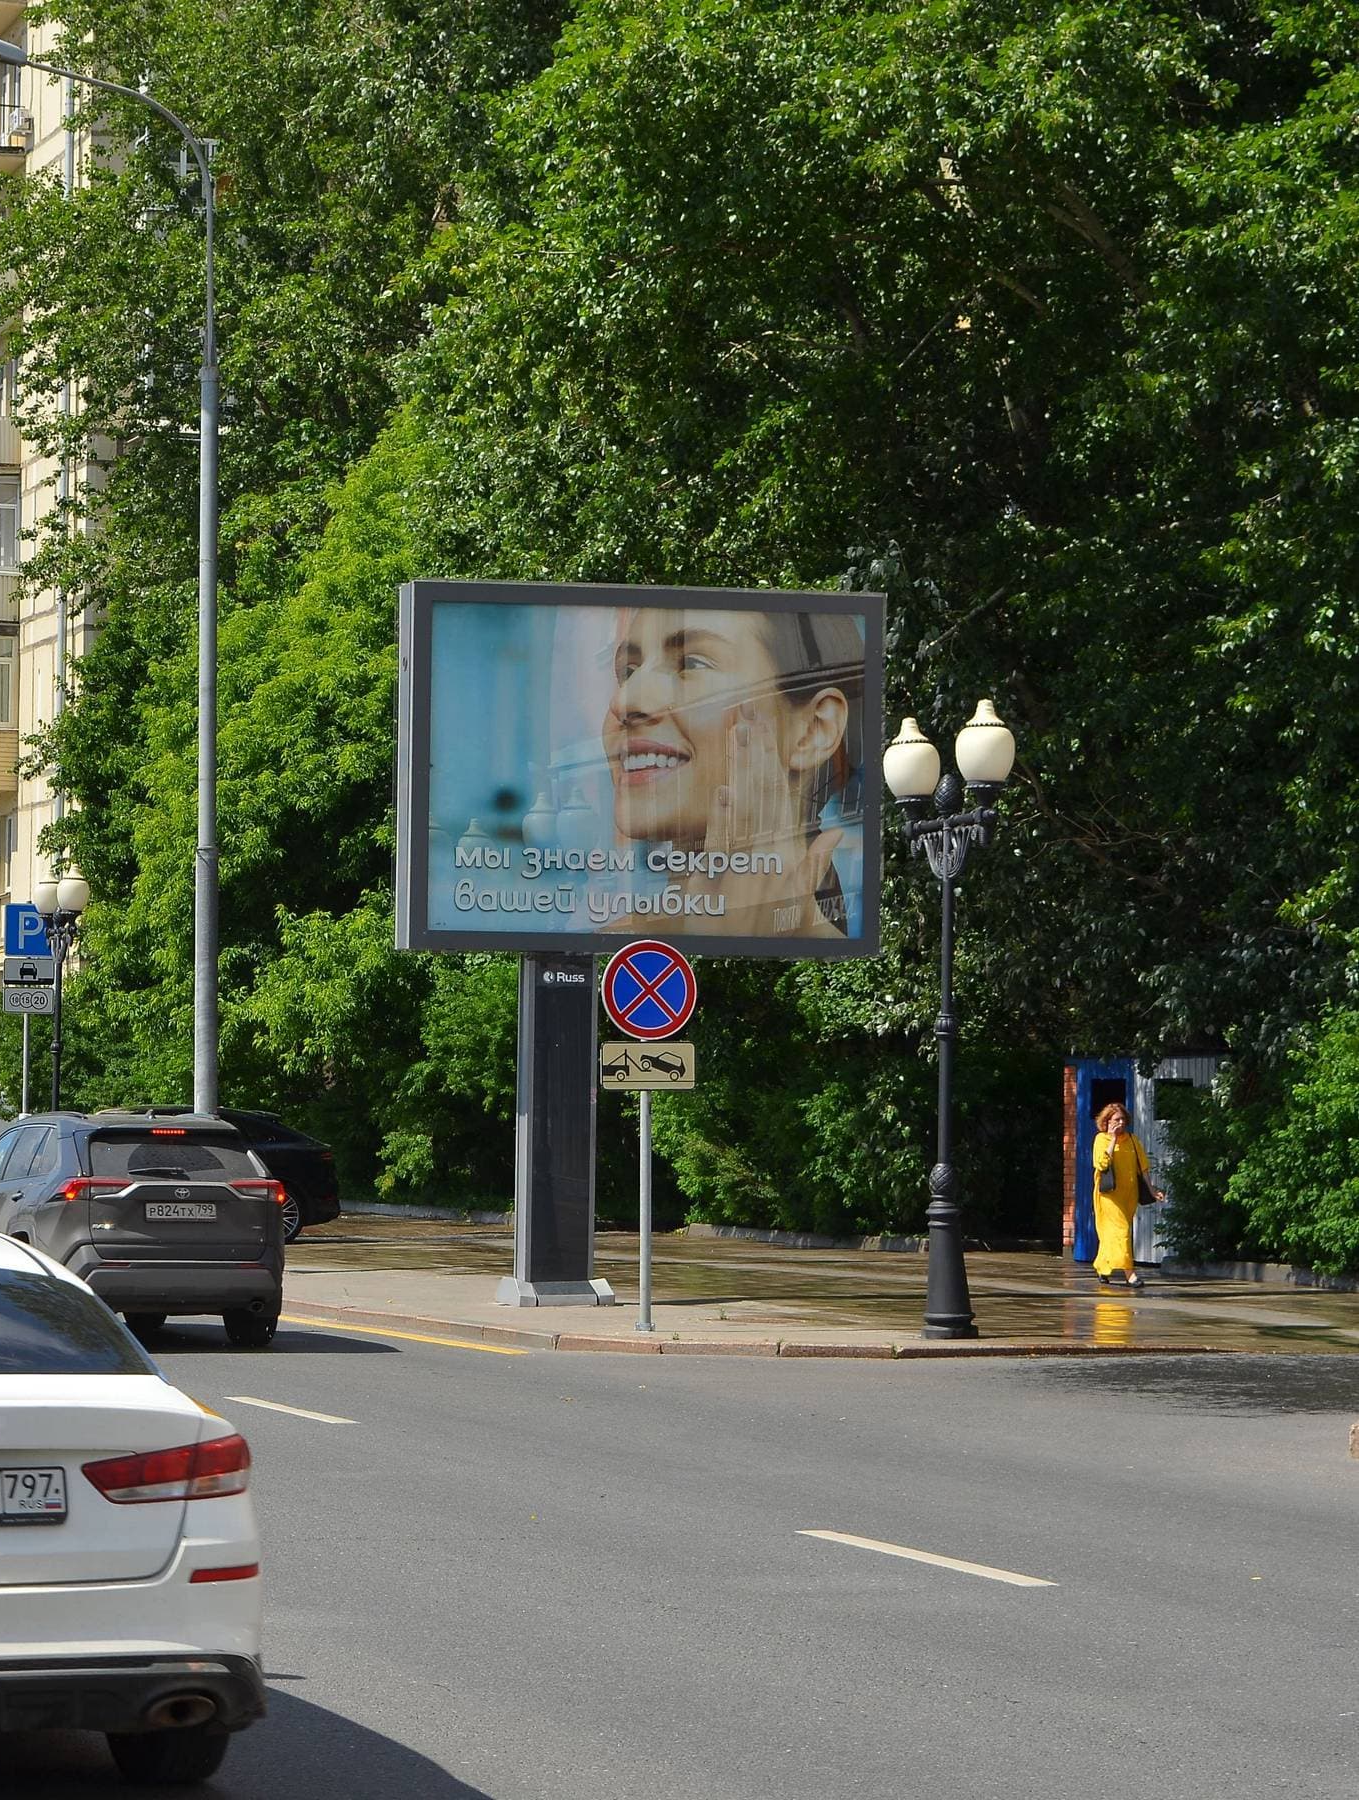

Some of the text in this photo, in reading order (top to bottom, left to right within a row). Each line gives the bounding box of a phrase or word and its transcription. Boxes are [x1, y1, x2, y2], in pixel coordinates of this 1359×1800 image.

[454, 845, 783, 879] мы знаем секрет
[453, 879, 726, 923] вашей улыбки
[18, 911, 43, 949] P
[556, 971, 585, 983] Russ
[34, 996, 45, 1005] 20
[149, 1205, 214, 1217] Р824ТХ 799
[4, 1473, 53, 1499] 797
[19, 1499, 43, 1509] RUS
